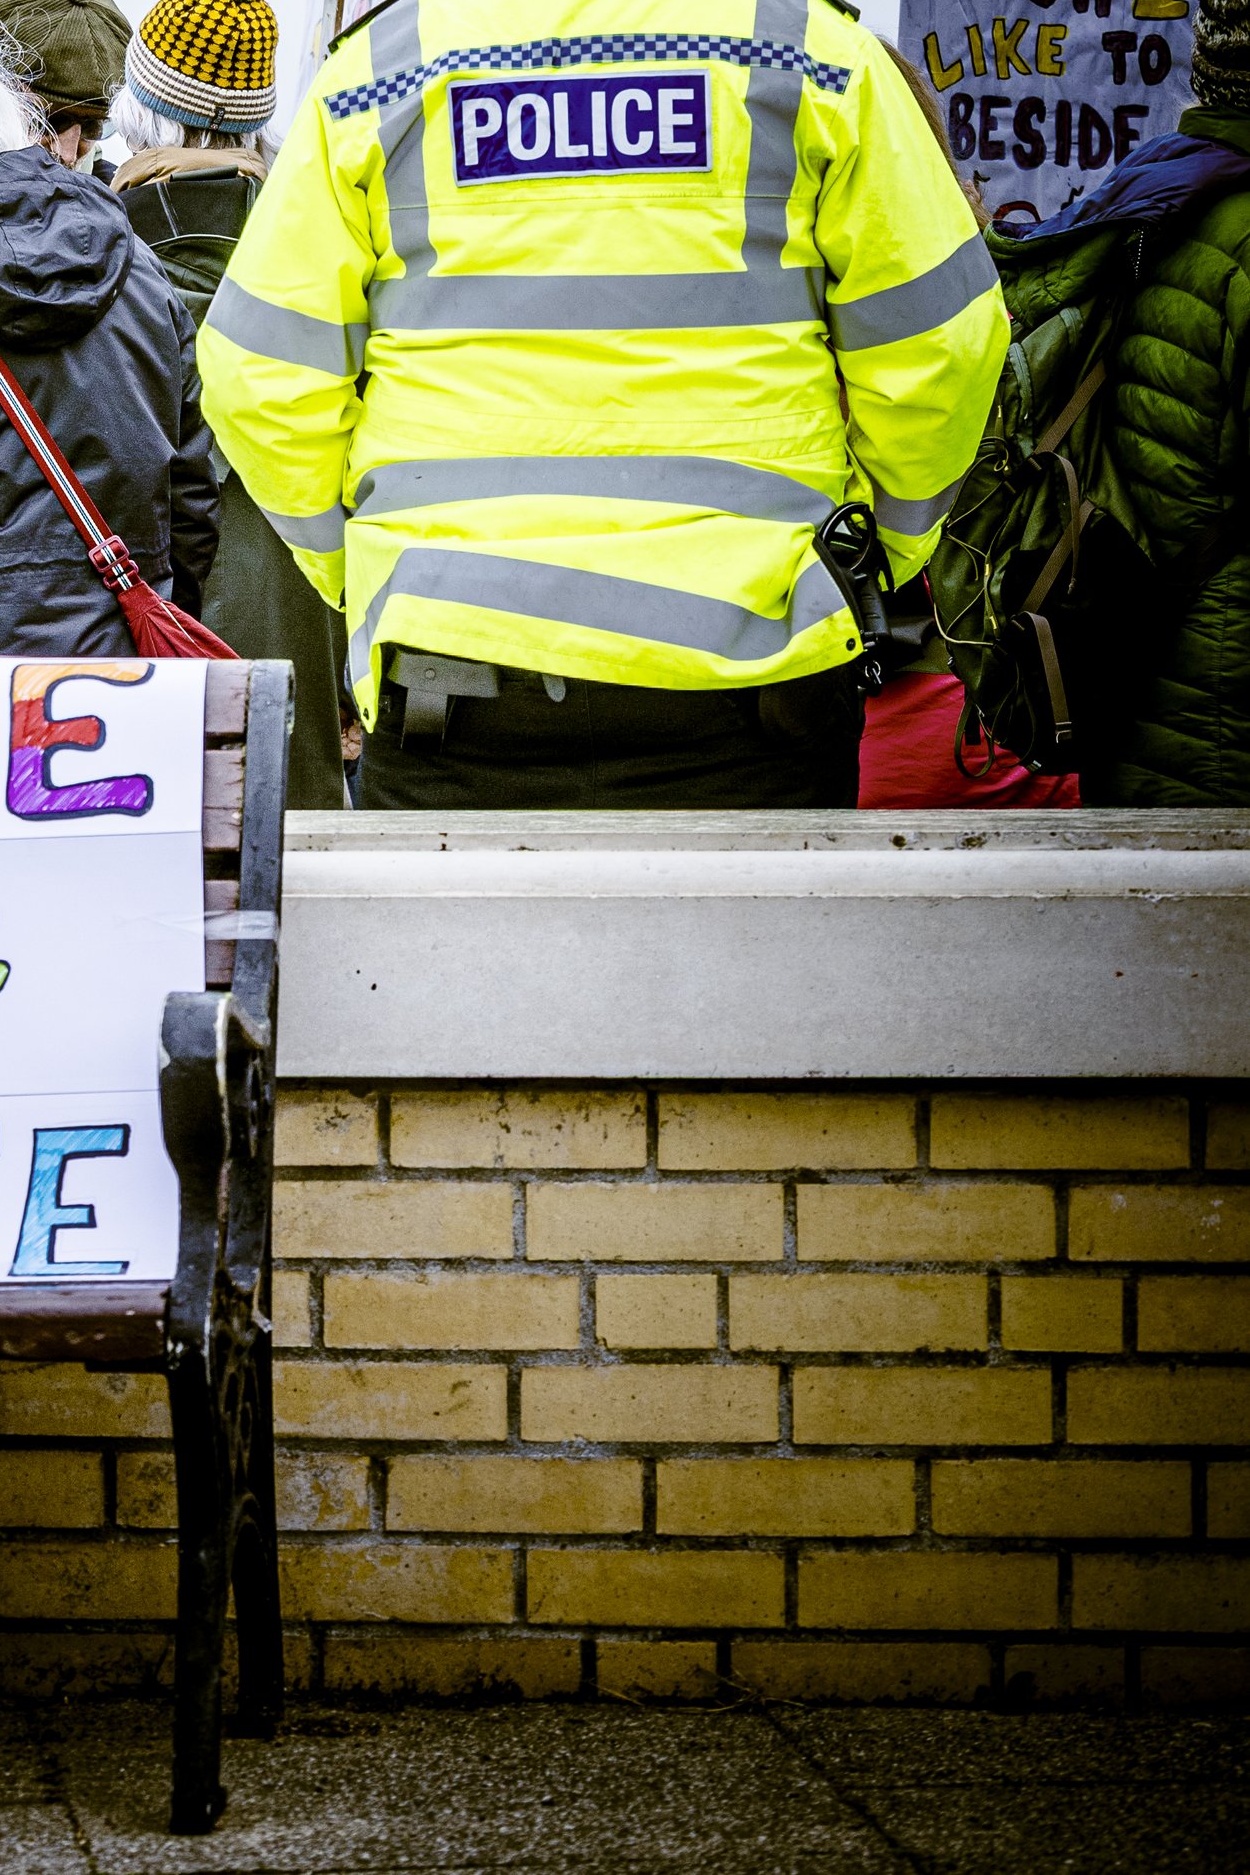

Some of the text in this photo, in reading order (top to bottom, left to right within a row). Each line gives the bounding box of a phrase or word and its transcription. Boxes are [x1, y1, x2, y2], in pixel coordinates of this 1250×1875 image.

[922, 16, 1172, 93] LIKE TO
[461, 88, 696, 166] POLICE
[948, 92, 1149, 171] BESIDE
